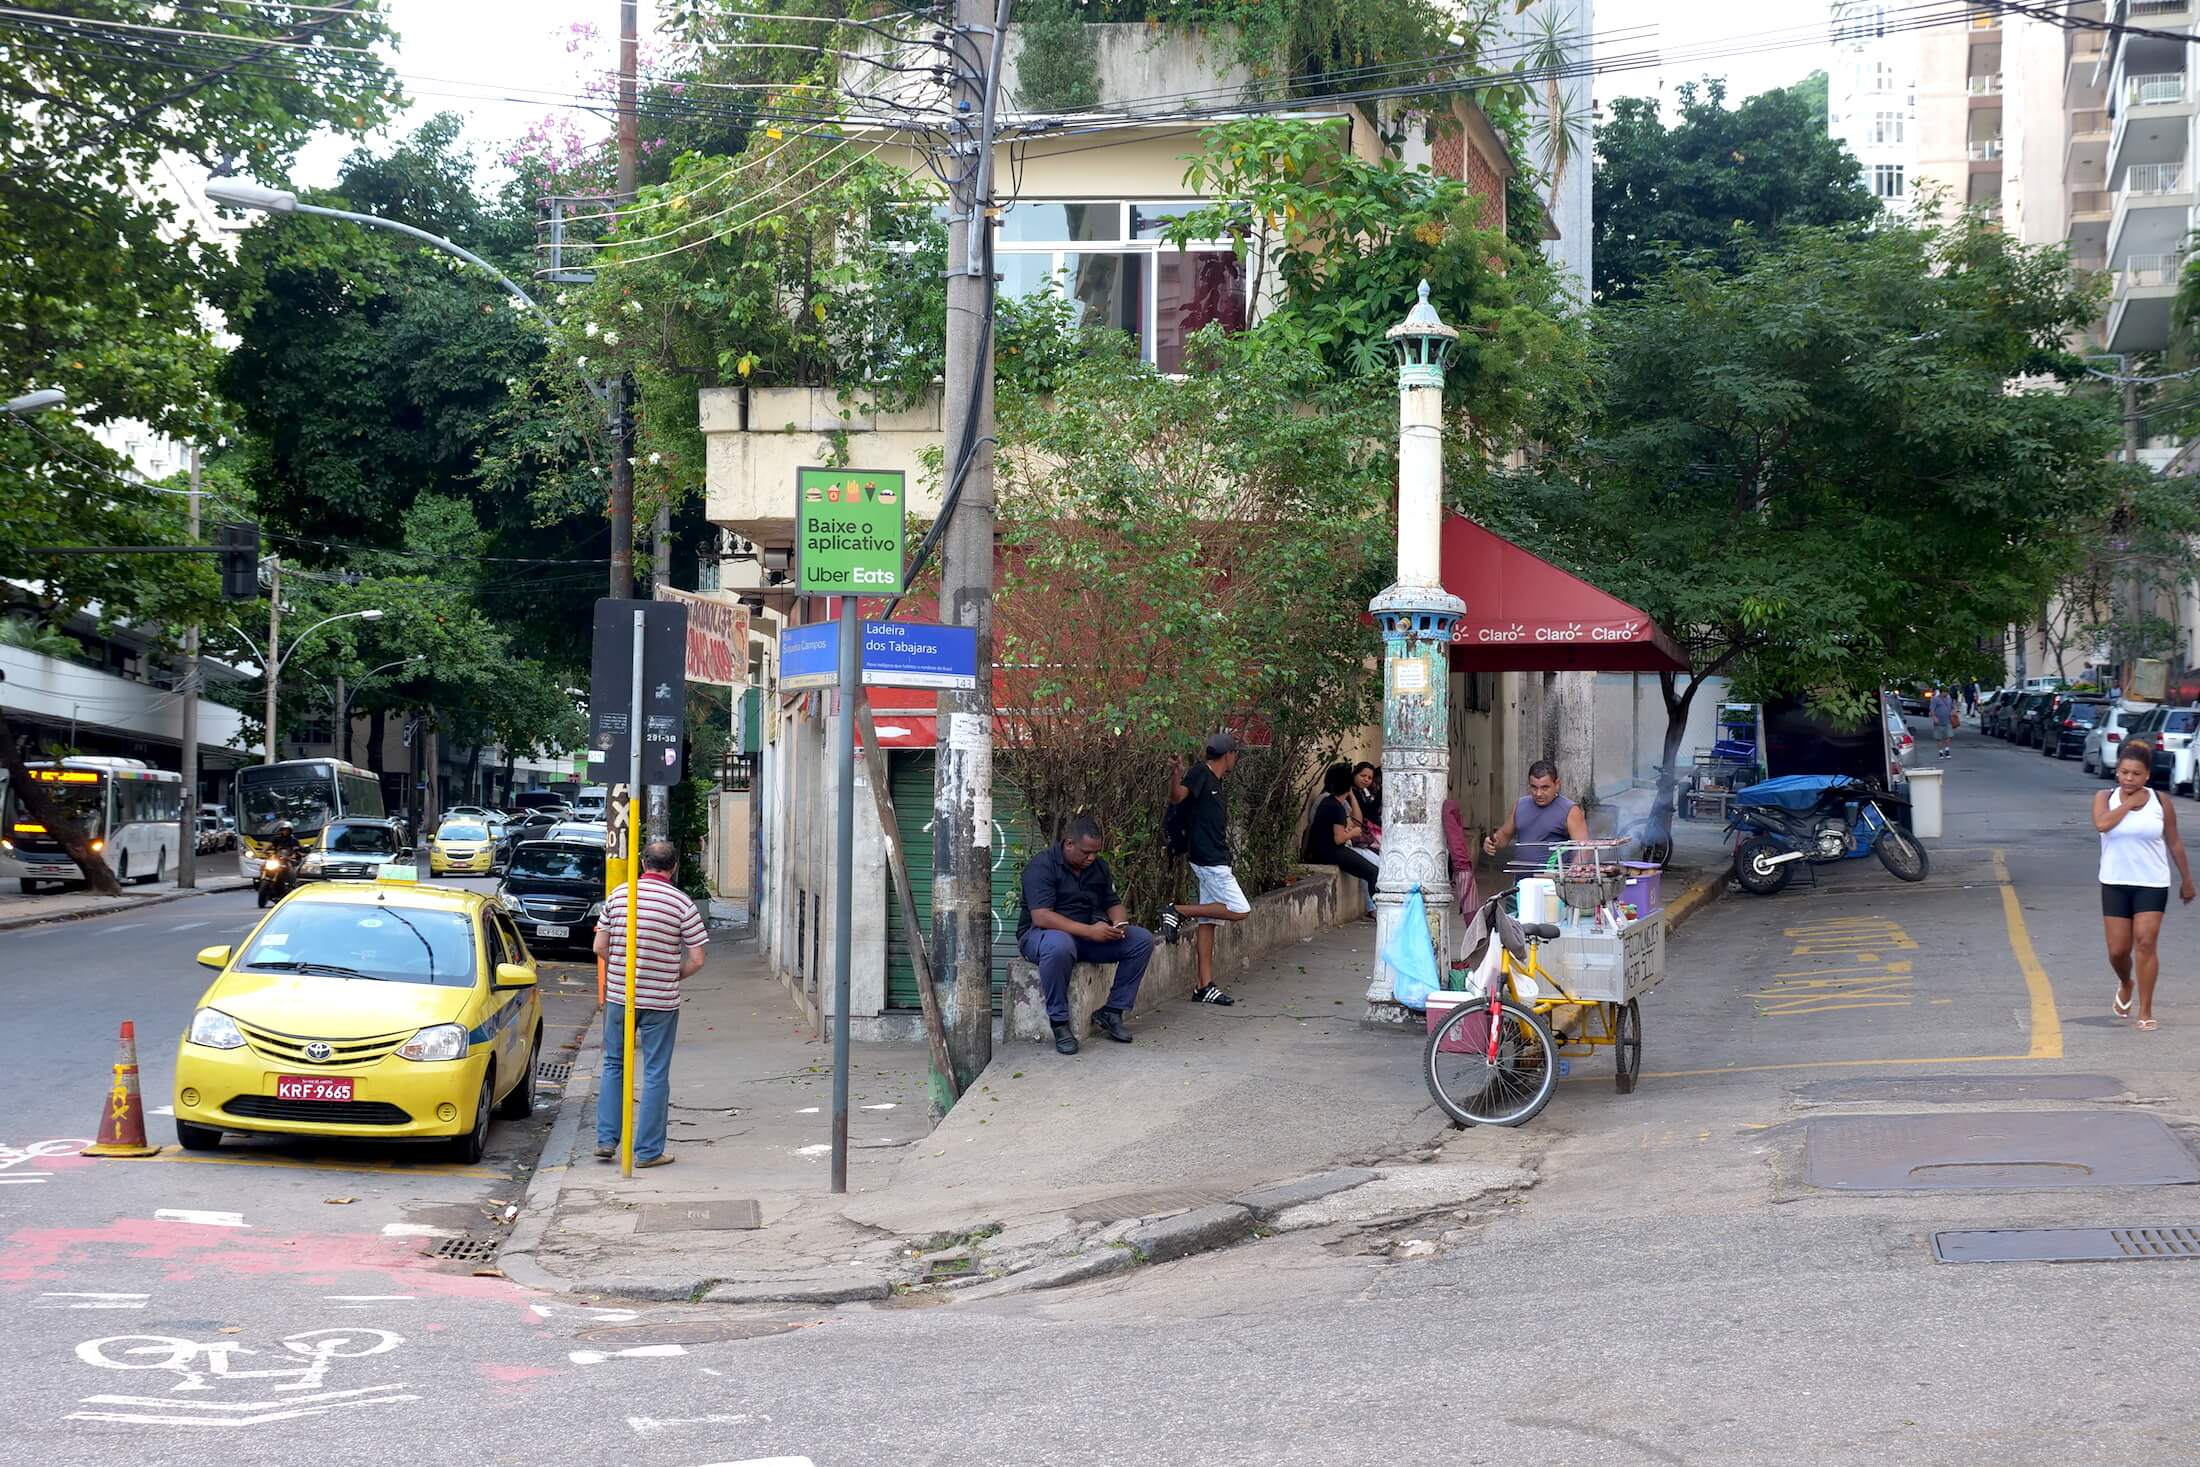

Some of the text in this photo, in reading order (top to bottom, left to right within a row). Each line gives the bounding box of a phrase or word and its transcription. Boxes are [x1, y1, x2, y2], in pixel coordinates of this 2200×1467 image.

[808, 518, 873, 535] Baixe o
[808, 535, 896, 554] aplicativo
[808, 566, 896, 584] Uber Eats
[866, 623, 905, 636] Ladeira
[1479, 628, 1518, 643] Claro
[1535, 627, 1574, 642] Claro
[1592, 626, 1632, 641] Claro
[866, 640, 938, 656] dos Tabajaras
[865, 673, 873, 683] 3
[956, 679, 972, 690] 143
